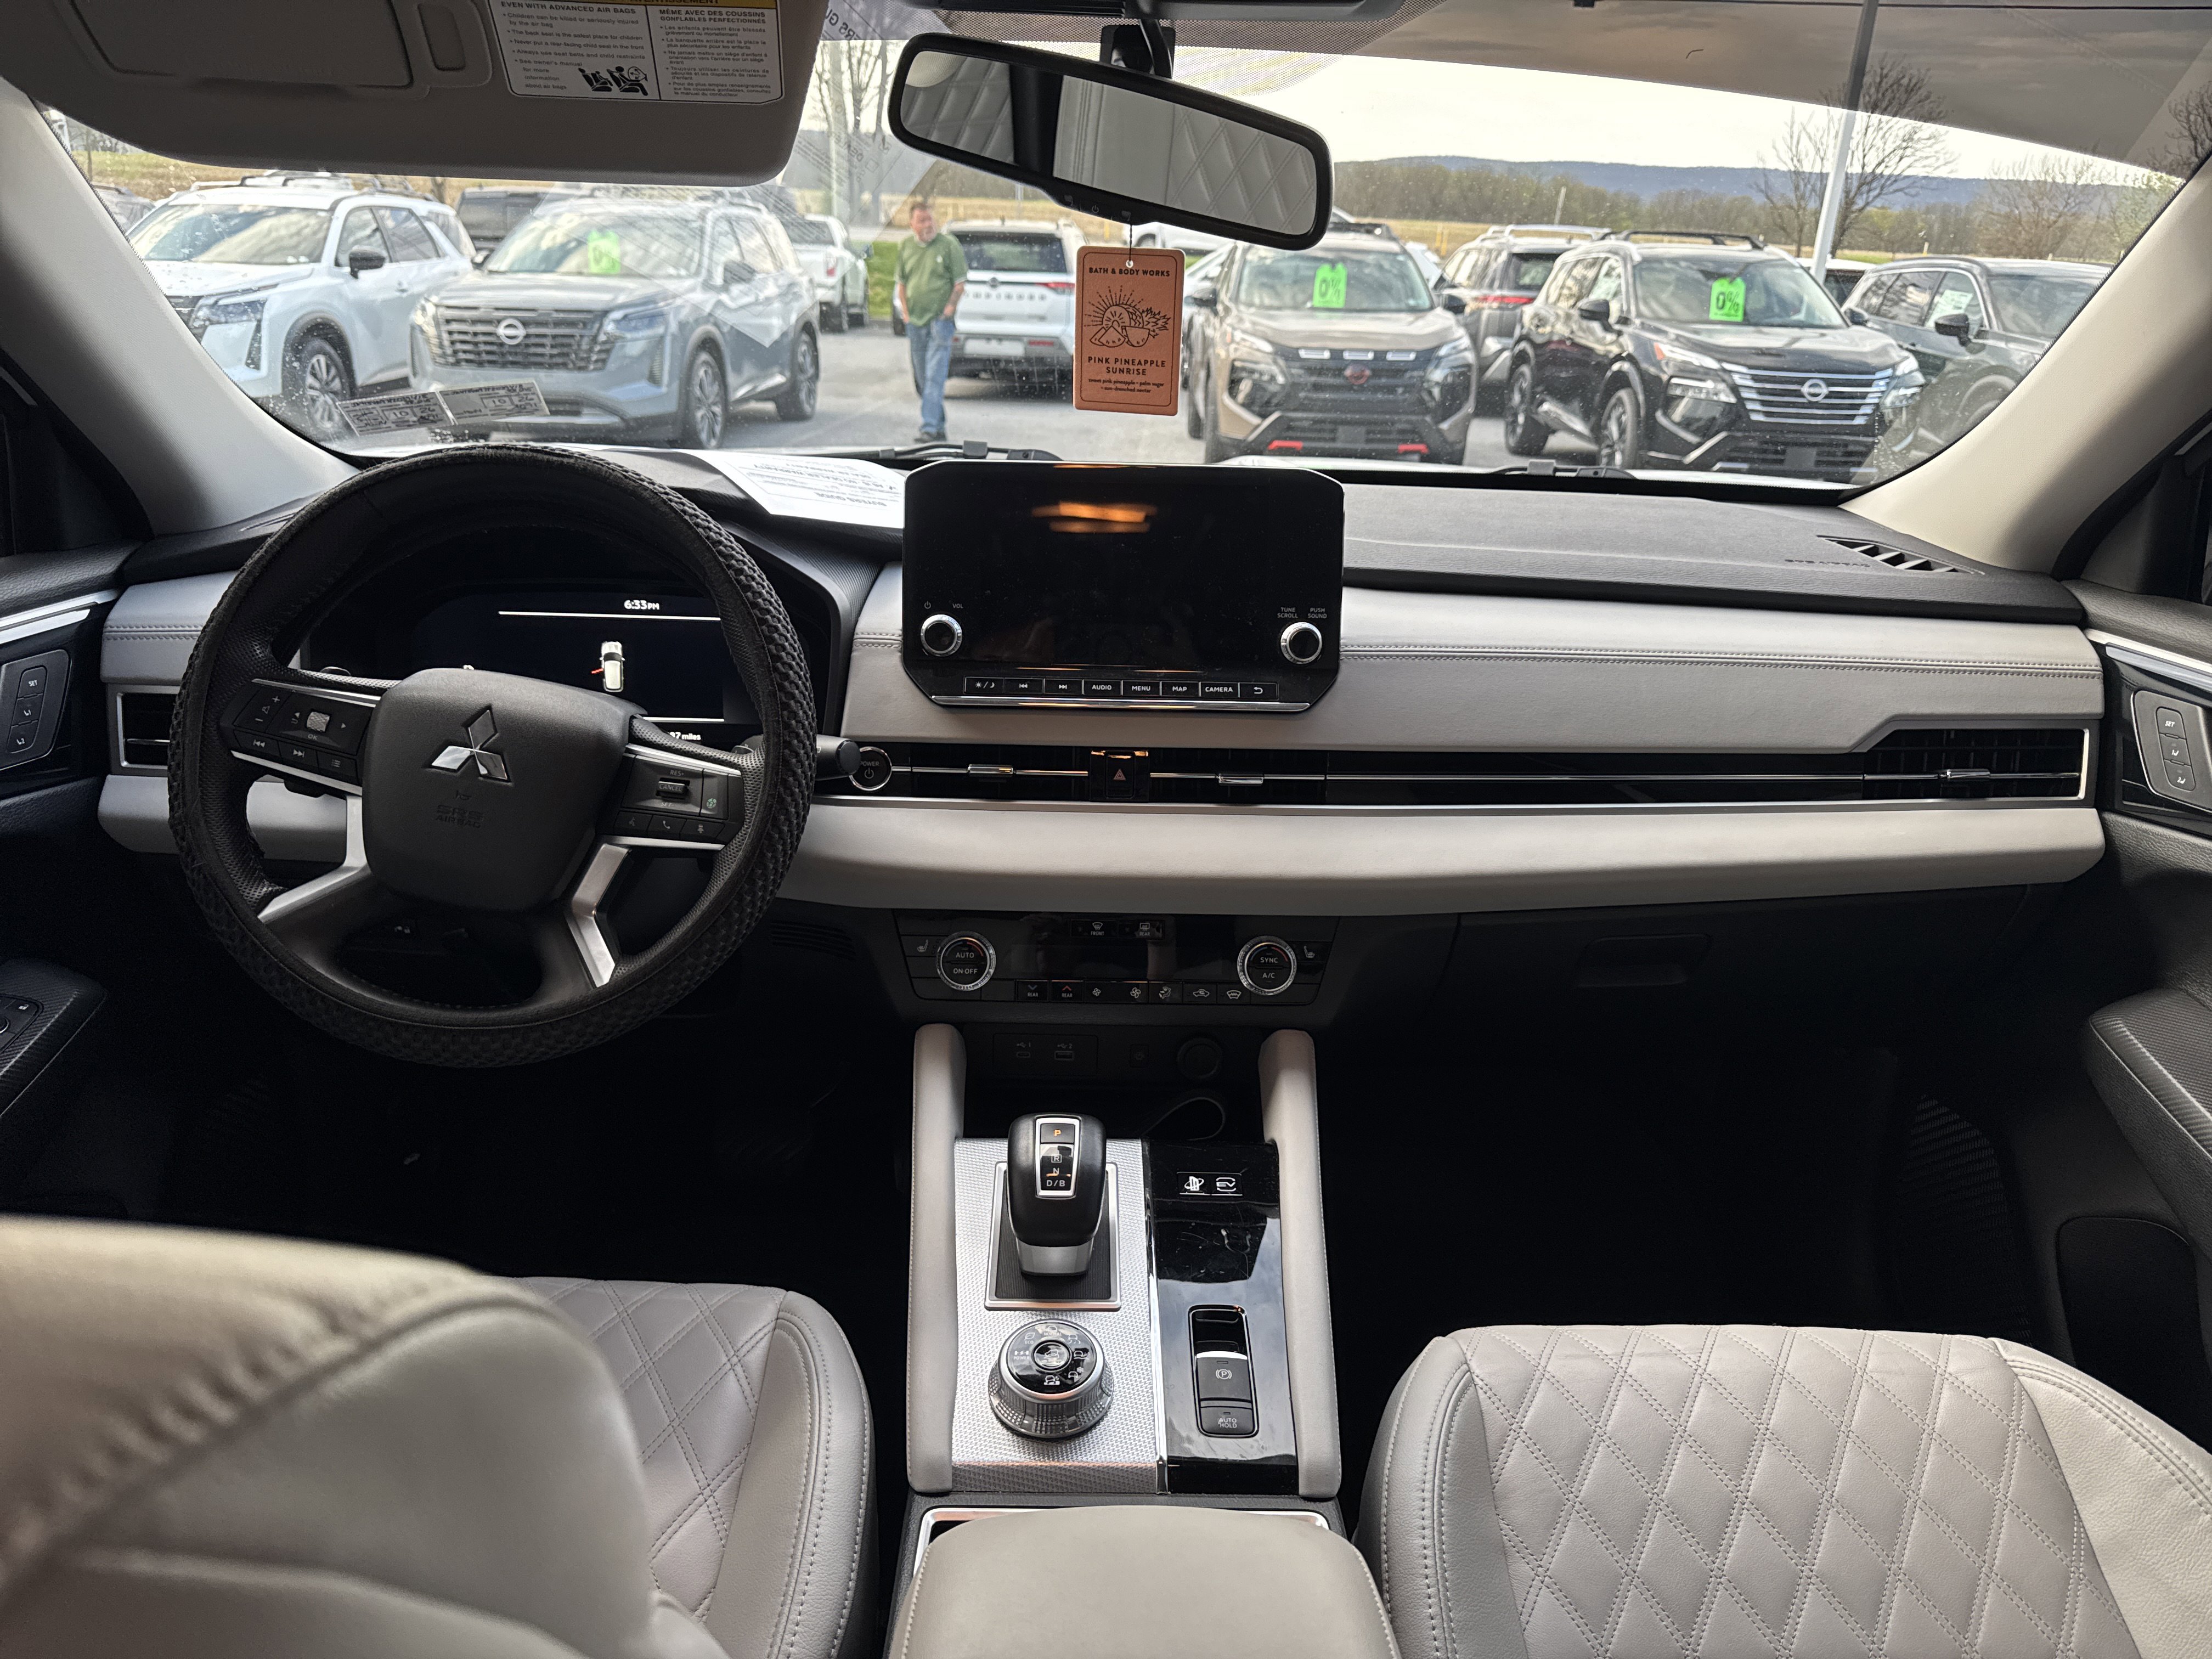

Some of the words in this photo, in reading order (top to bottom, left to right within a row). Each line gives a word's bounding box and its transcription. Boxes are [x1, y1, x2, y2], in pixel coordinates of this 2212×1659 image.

[1318, 278, 1341, 300] 0%
[1716, 291, 1740, 313] 0%
[1114, 358, 1166, 368] PINEAPPLE
[1106, 366, 1147, 376] SUNRISE
[437, 804, 483, 822] SRS
[435, 815, 482, 828] AIRBAG
